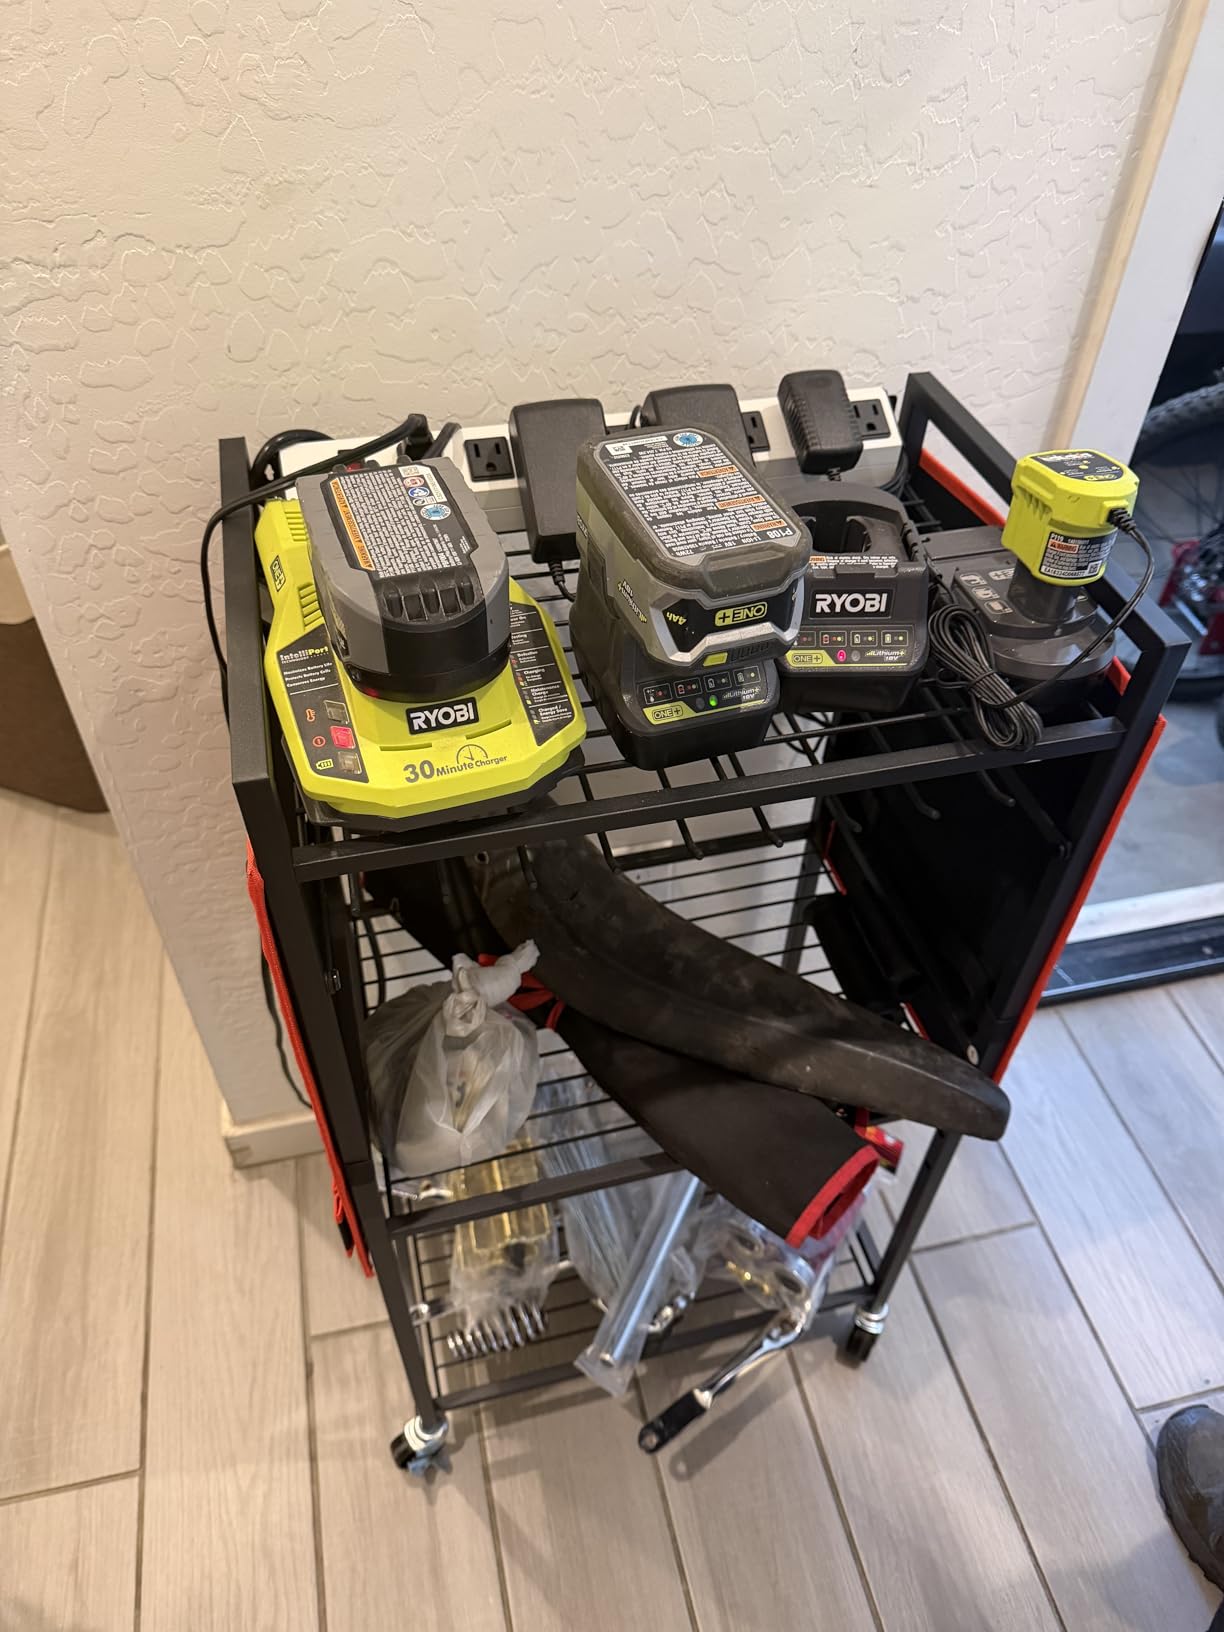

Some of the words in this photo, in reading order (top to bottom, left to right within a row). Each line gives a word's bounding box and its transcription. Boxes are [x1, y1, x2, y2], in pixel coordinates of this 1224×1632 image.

[766, 527, 793, 538] P108
[815, 593, 888, 613] RYOBI
[666, 611, 687, 625] 4Ah
[718, 604, 765, 624] ONE+
[280, 646, 328, 661] IntelliPort
[793, 655, 821, 663] ONE+
[409, 702, 475, 731] RYOBI
[654, 707, 681, 718] ONE+
[403, 759, 435, 783] 30
[436, 761, 474, 776] Minute
[475, 755, 508, 767] Charger
